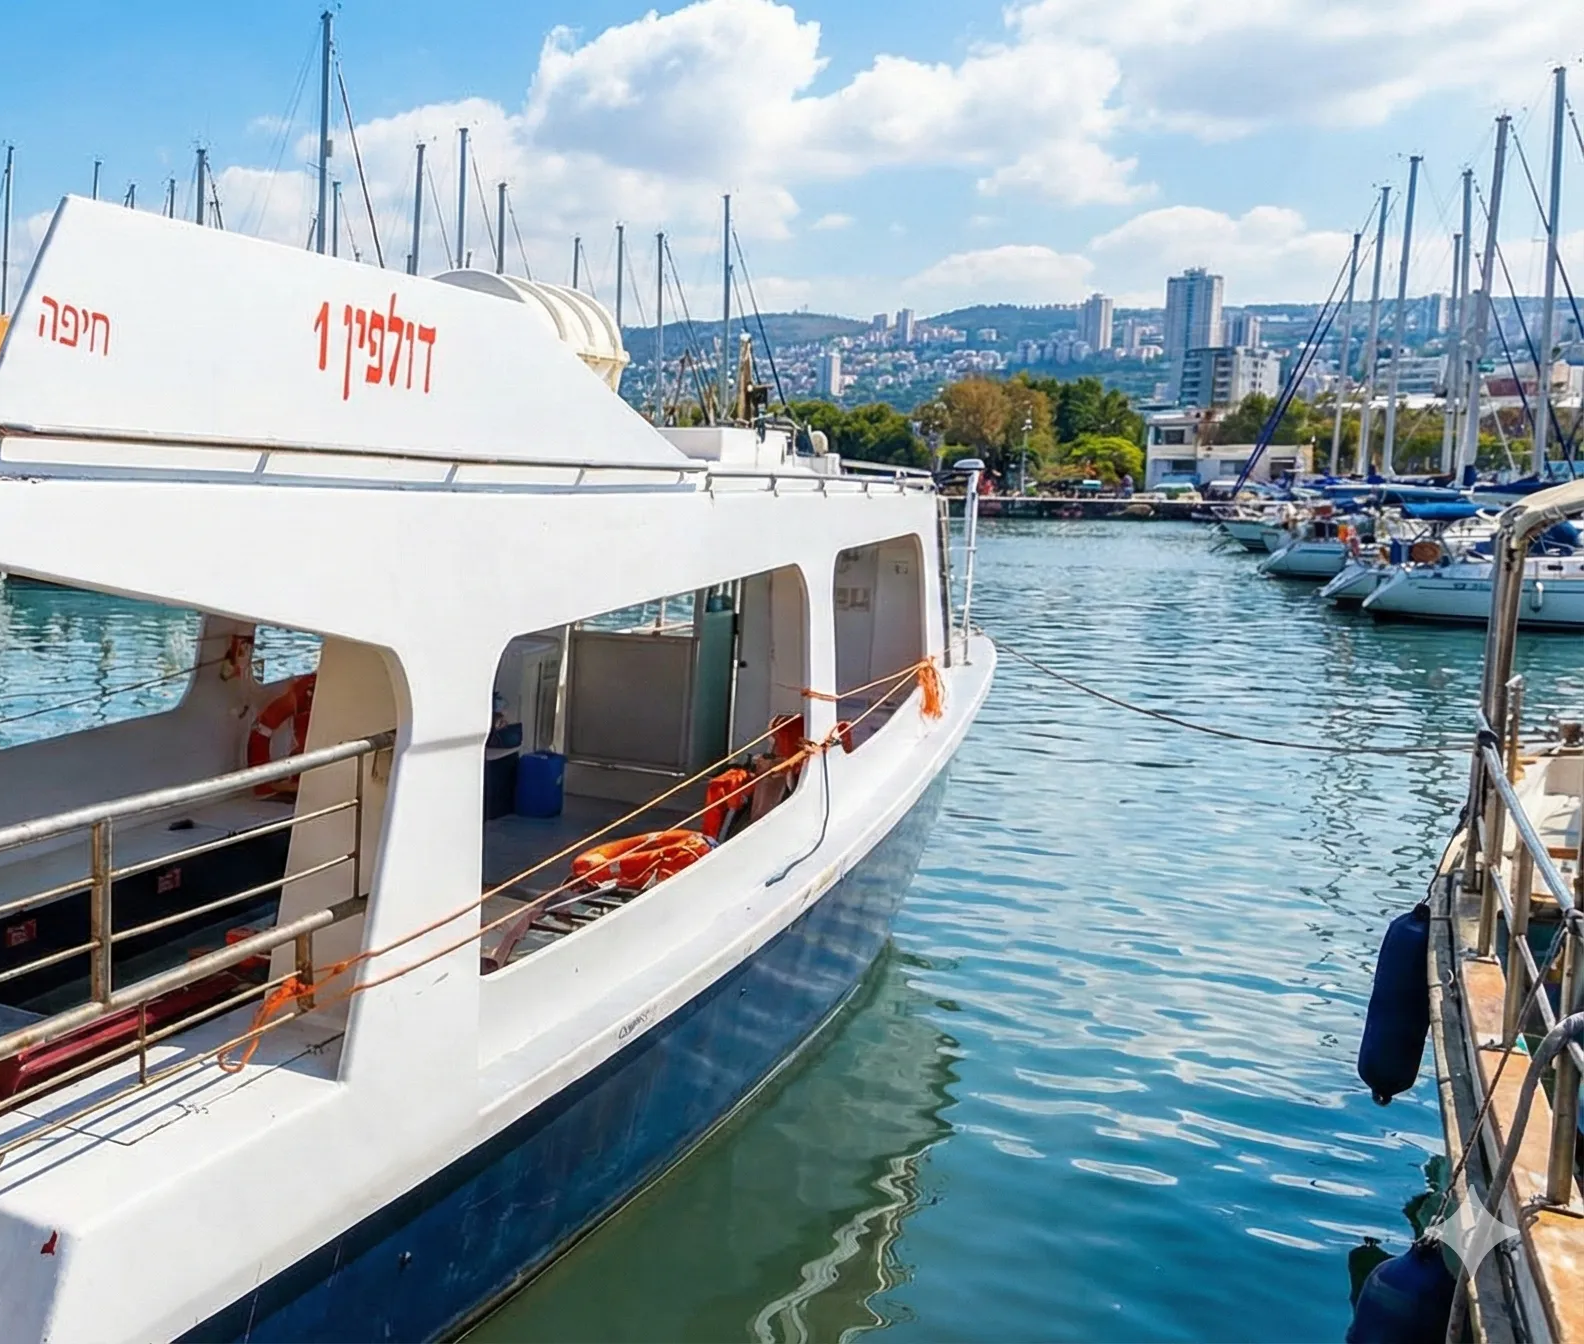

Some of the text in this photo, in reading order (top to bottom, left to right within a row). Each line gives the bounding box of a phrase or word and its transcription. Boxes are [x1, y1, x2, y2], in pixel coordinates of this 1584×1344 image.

[38, 295, 111, 355] חיפה
[314, 293, 437, 401] דולפין 1
